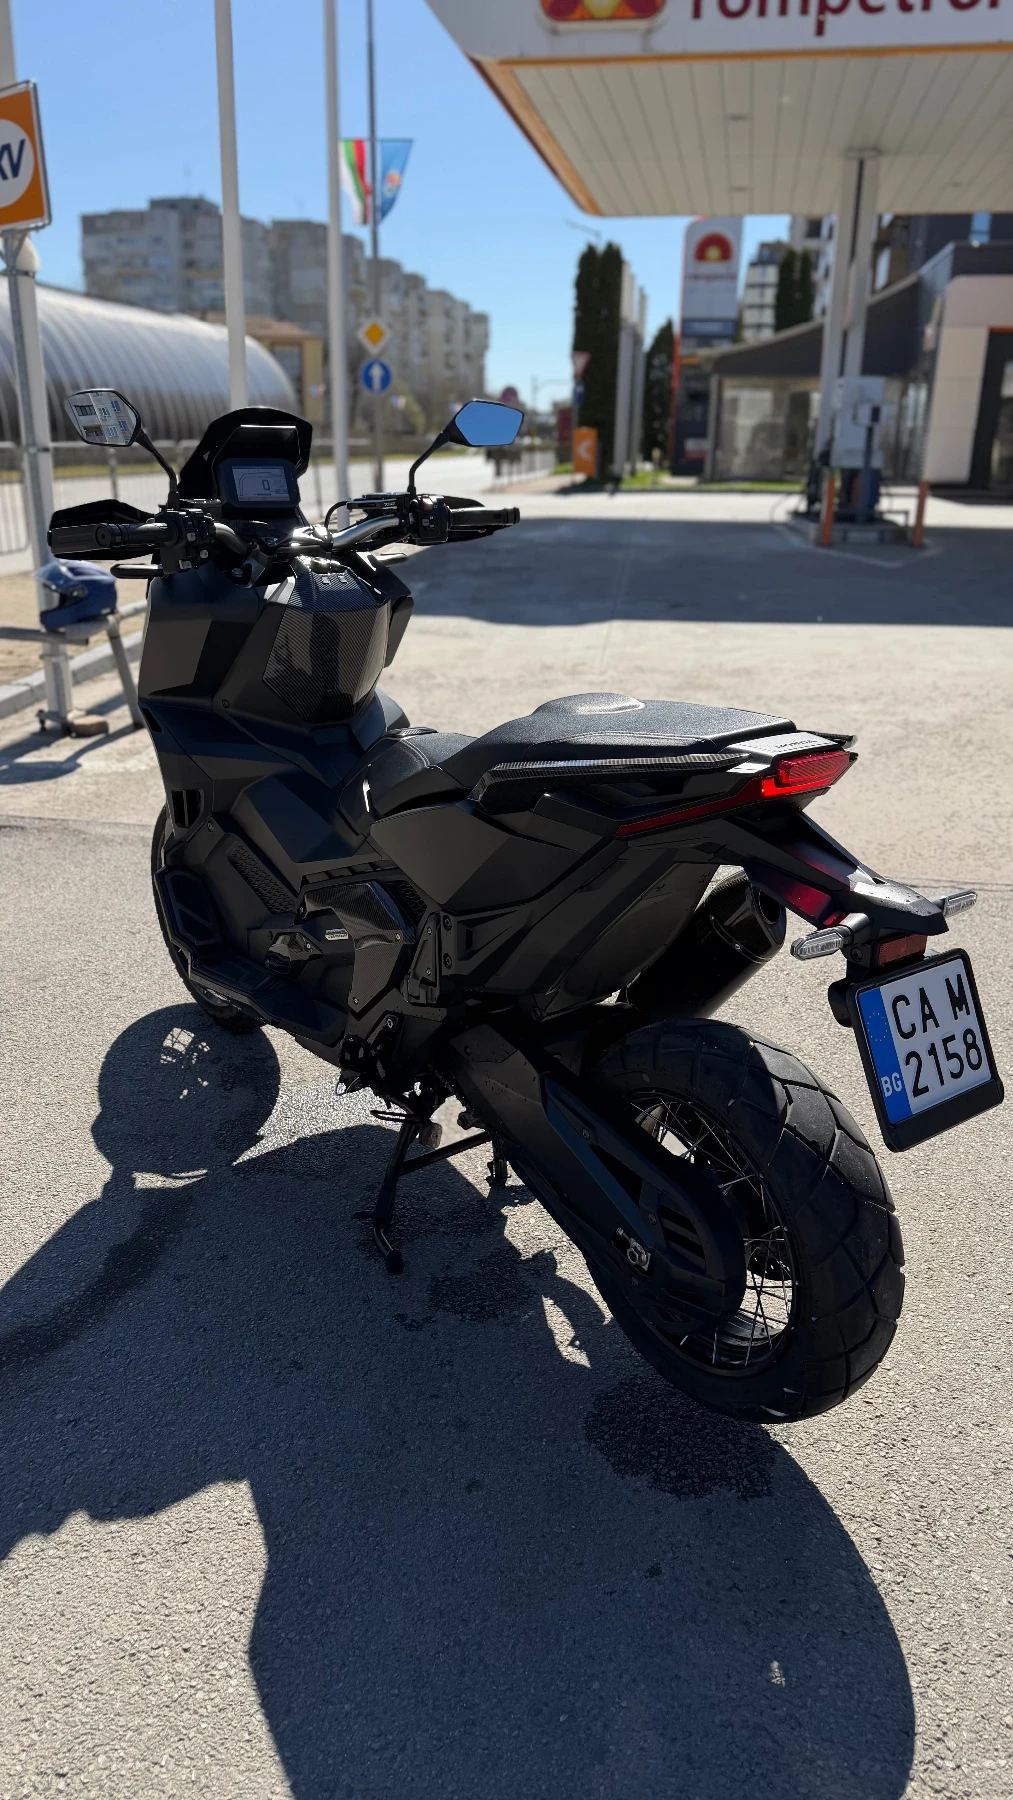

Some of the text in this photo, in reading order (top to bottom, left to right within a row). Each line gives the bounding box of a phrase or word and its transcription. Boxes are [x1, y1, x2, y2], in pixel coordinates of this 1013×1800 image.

[262, 479, 271, 491] 0
[891, 973, 971, 1040] CA M
[880, 1071, 903, 1098] BG
[905, 1028, 983, 1099] 2158
